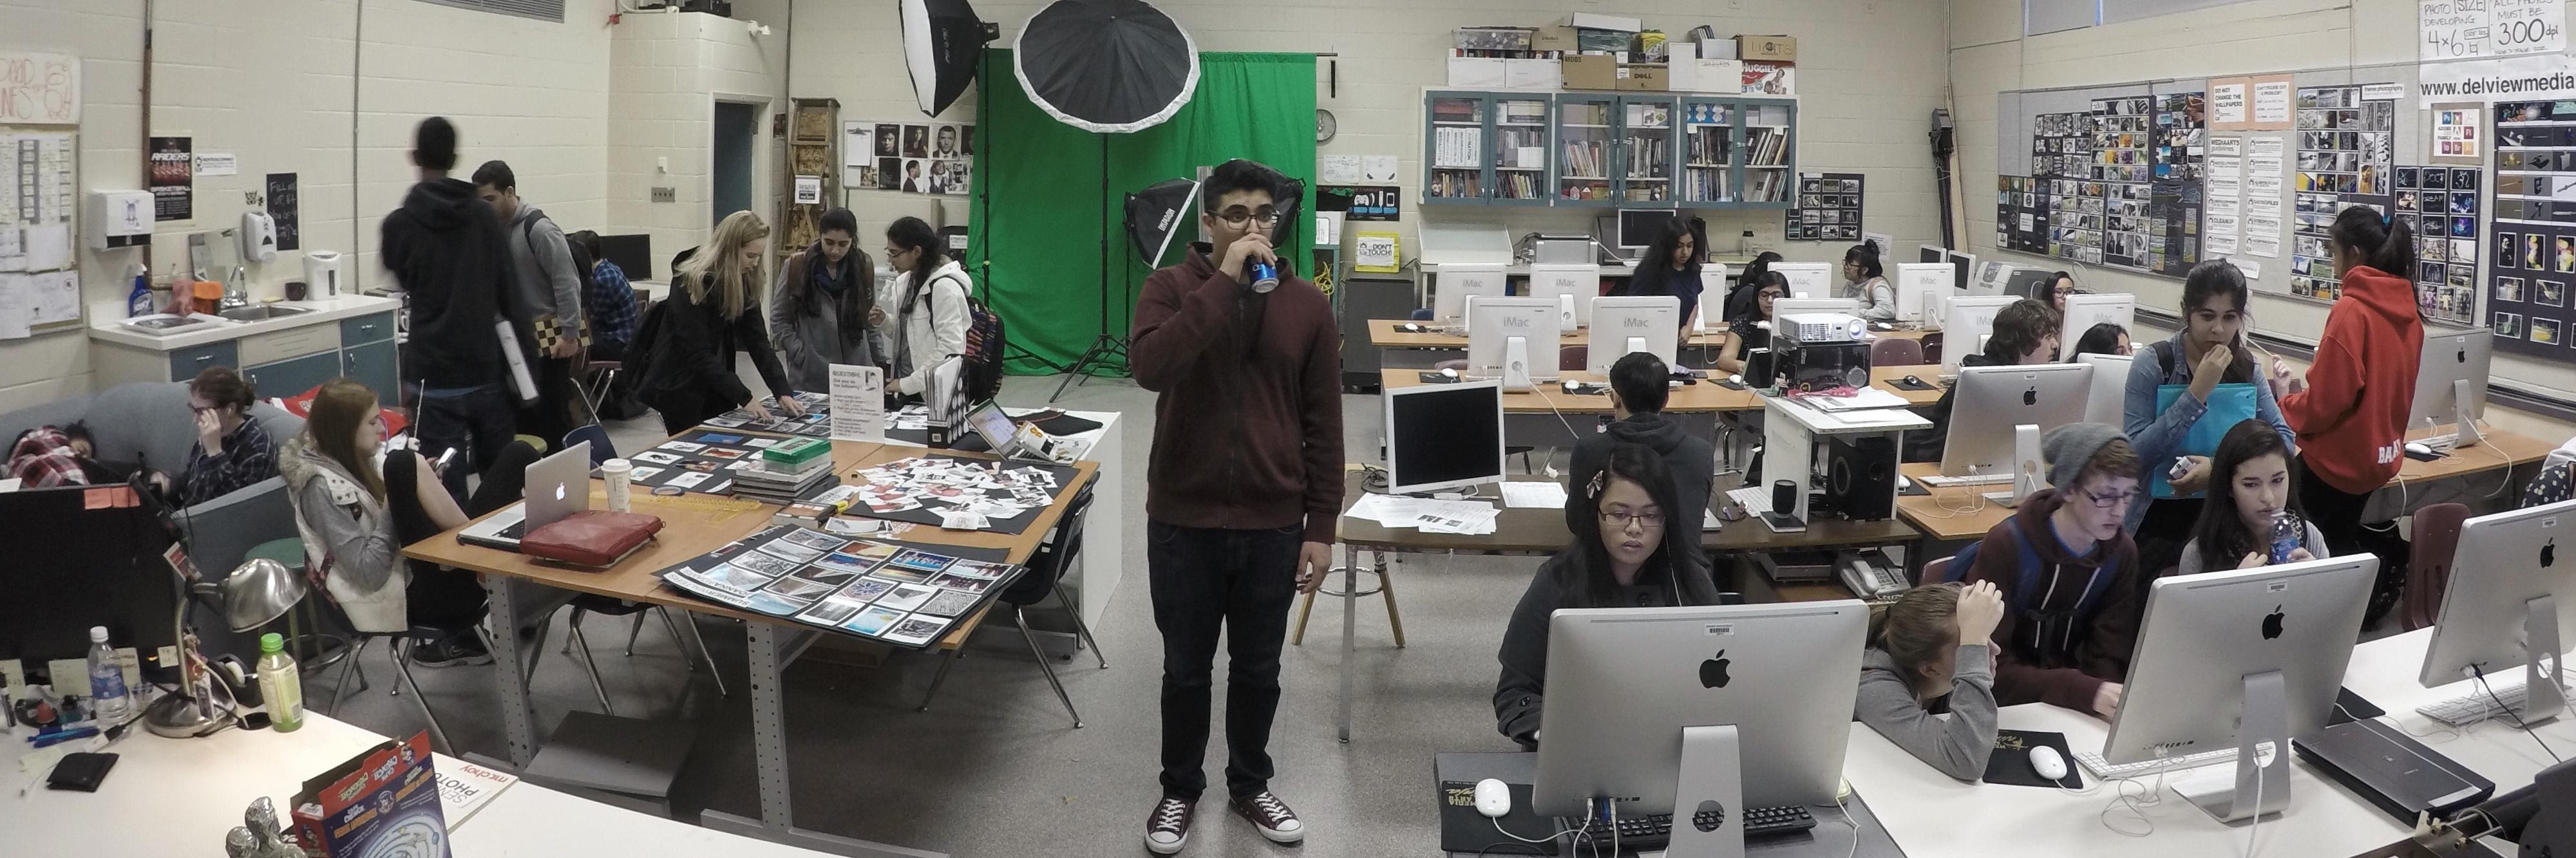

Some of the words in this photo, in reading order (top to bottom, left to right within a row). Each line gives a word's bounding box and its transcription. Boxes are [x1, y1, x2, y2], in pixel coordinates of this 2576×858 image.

[2424, 4, 2450, 15] PHOTO
[2497, 8, 2523, 19] MUST
[2528, 7, 2546, 17] BE
[2424, 15, 2476, 26] DEVELOPING
[2498, 18, 2544, 46] 300
[2545, 24, 2559, 40] dpi
[1741, 62, 1776, 73] HUGGIES
[2420, 71, 2575, 96] www.delviewmedia
[151, 152, 191, 161] RAIDERS
[1463, 279, 1482, 288] iMac
[1555, 278, 1576, 286] iMac
[135, 299, 151, 312] oxy
[1503, 317, 1530, 327] iMac
[1624, 318, 1649, 327] iMac
[1976, 314, 1995, 325] iMa
[2094, 313, 2112, 322] iMac
[708, 591, 750, 606] SUMMER
[435, 772, 480, 797] PHOTO
[438, 785, 468, 804] SEN
